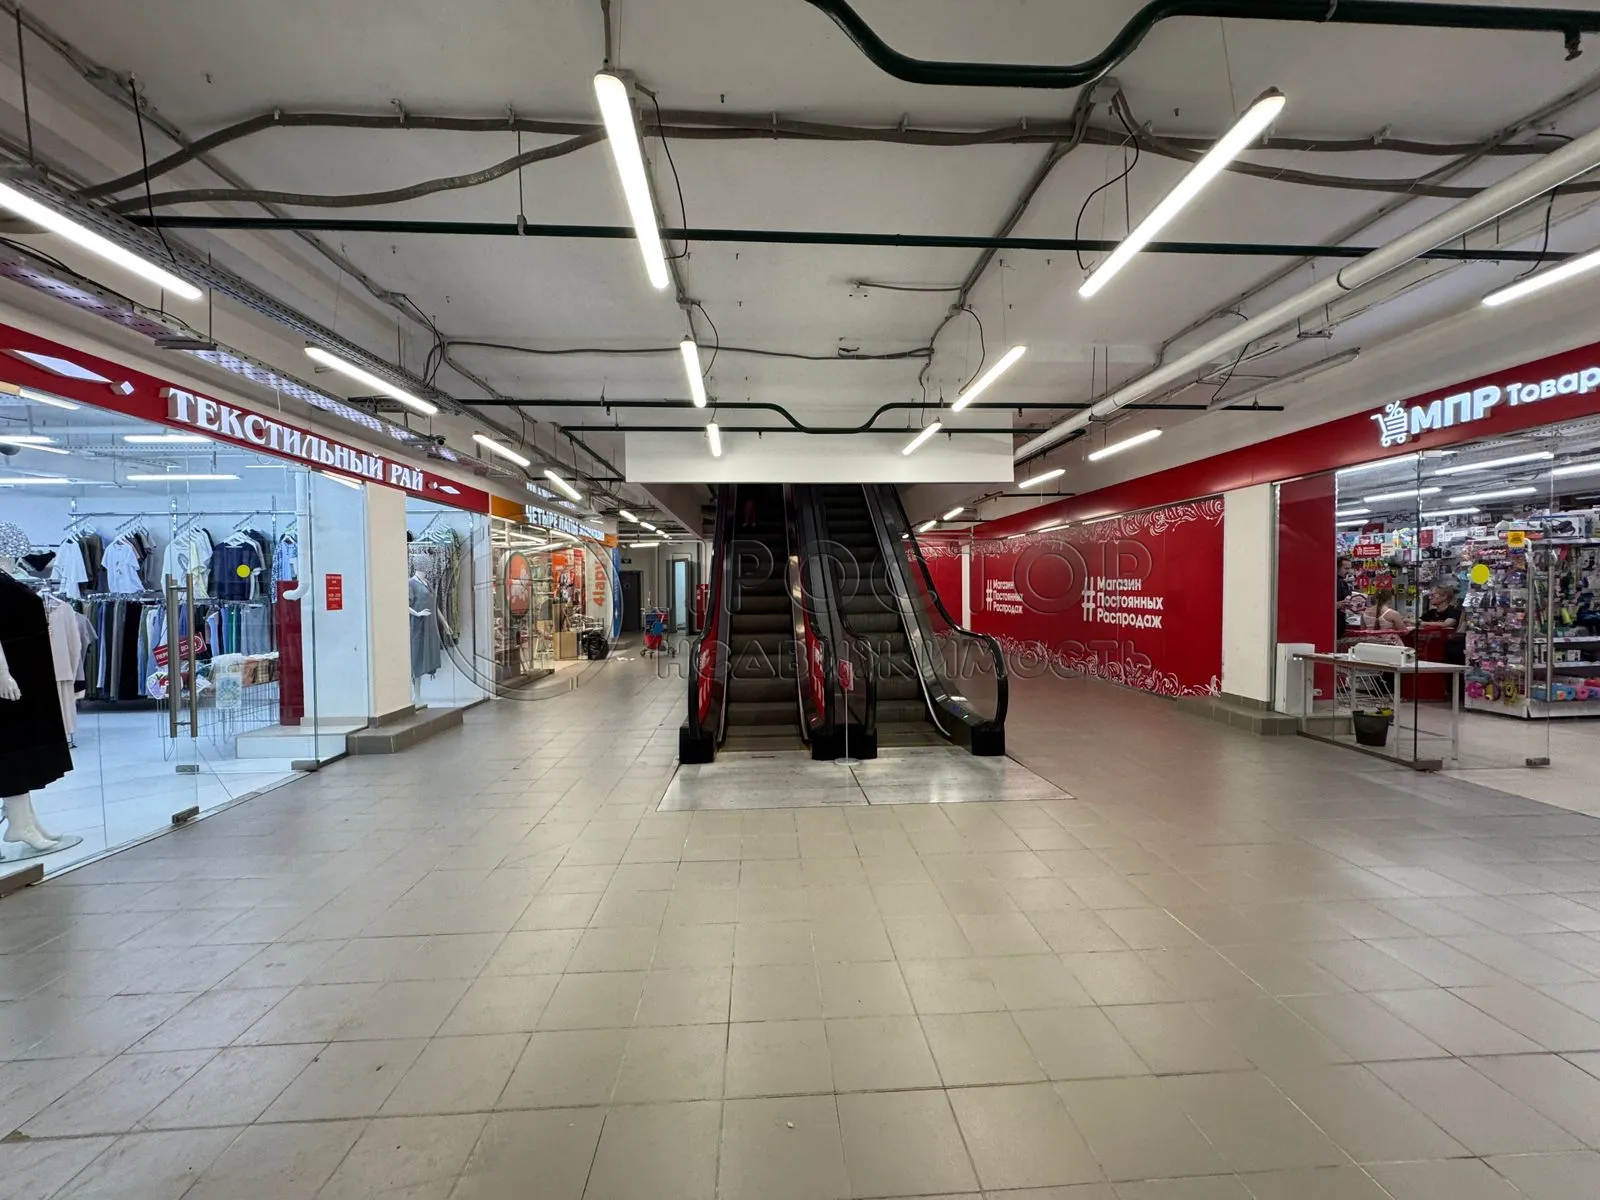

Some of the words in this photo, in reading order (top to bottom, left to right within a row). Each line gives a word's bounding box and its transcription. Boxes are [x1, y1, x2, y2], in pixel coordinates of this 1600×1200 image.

[1410, 385, 1502, 435] МПР
[167, 387, 384, 481] ТЕКСТИЛЬНЫЙ
[390, 462, 425, 491] РАЙ
[525, 504, 558, 528] ЧЕТЫРЕ
[1097, 576, 1142, 592] Магазин
[993, 601, 1024, 615] Распродаж
[1097, 592, 1164, 611] Постоянных
[1097, 608, 1162, 629] Распродаж
